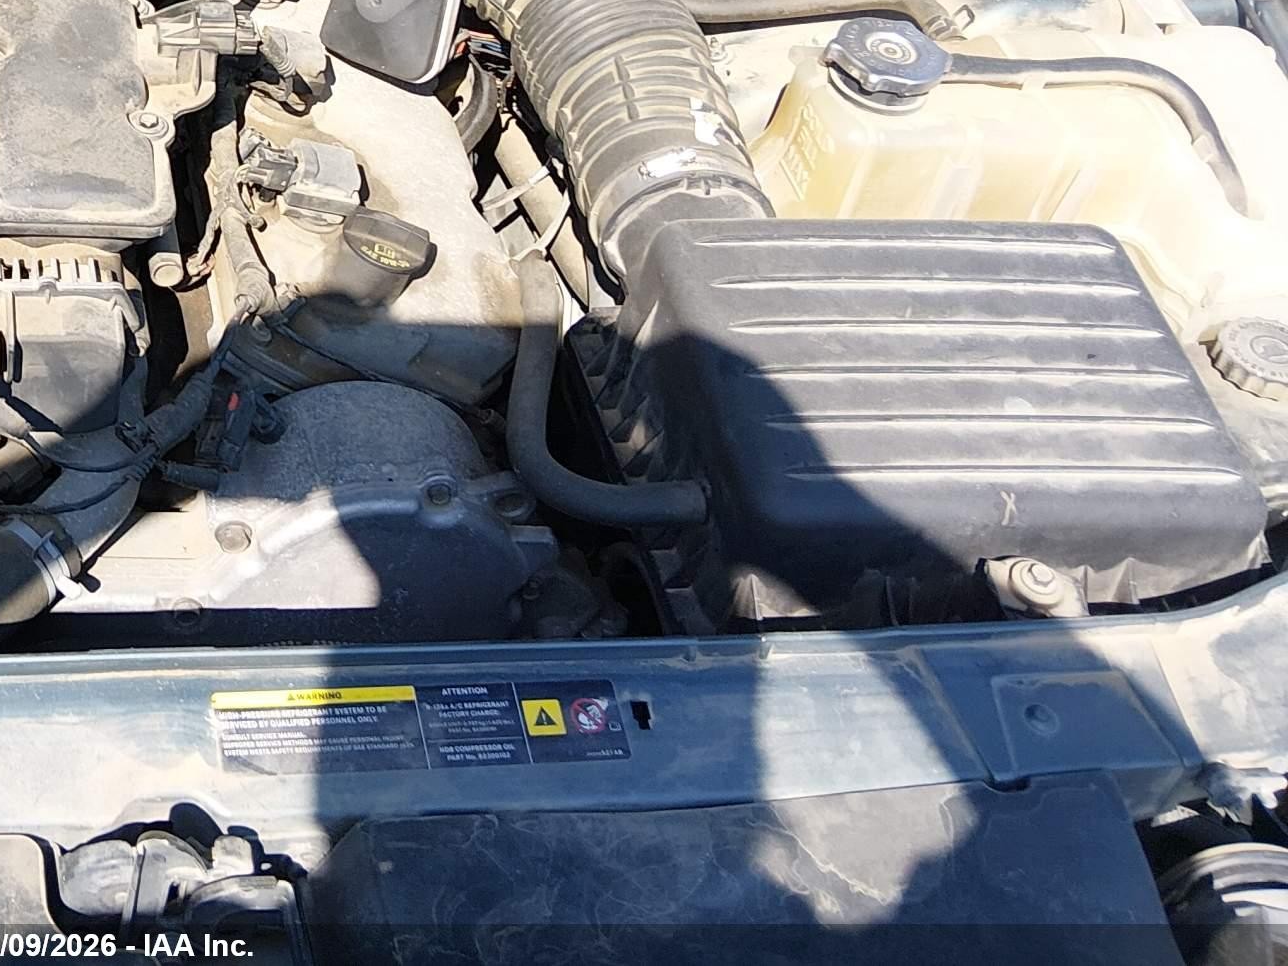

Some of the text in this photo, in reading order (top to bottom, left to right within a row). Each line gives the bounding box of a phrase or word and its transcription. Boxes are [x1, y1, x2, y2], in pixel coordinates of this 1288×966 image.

[296, 691, 342, 700] WARNING
[442, 687, 488, 696] ATTENTION
[334, 705, 364, 715] SYSTEM
[365, 705, 376, 713] TO
[377, 705, 387, 713] BE
[259, 720, 269, 728] BY
[312, 716, 356, 726] PERSONNEL
[455, 744, 502, 752] COMPRESSOR
